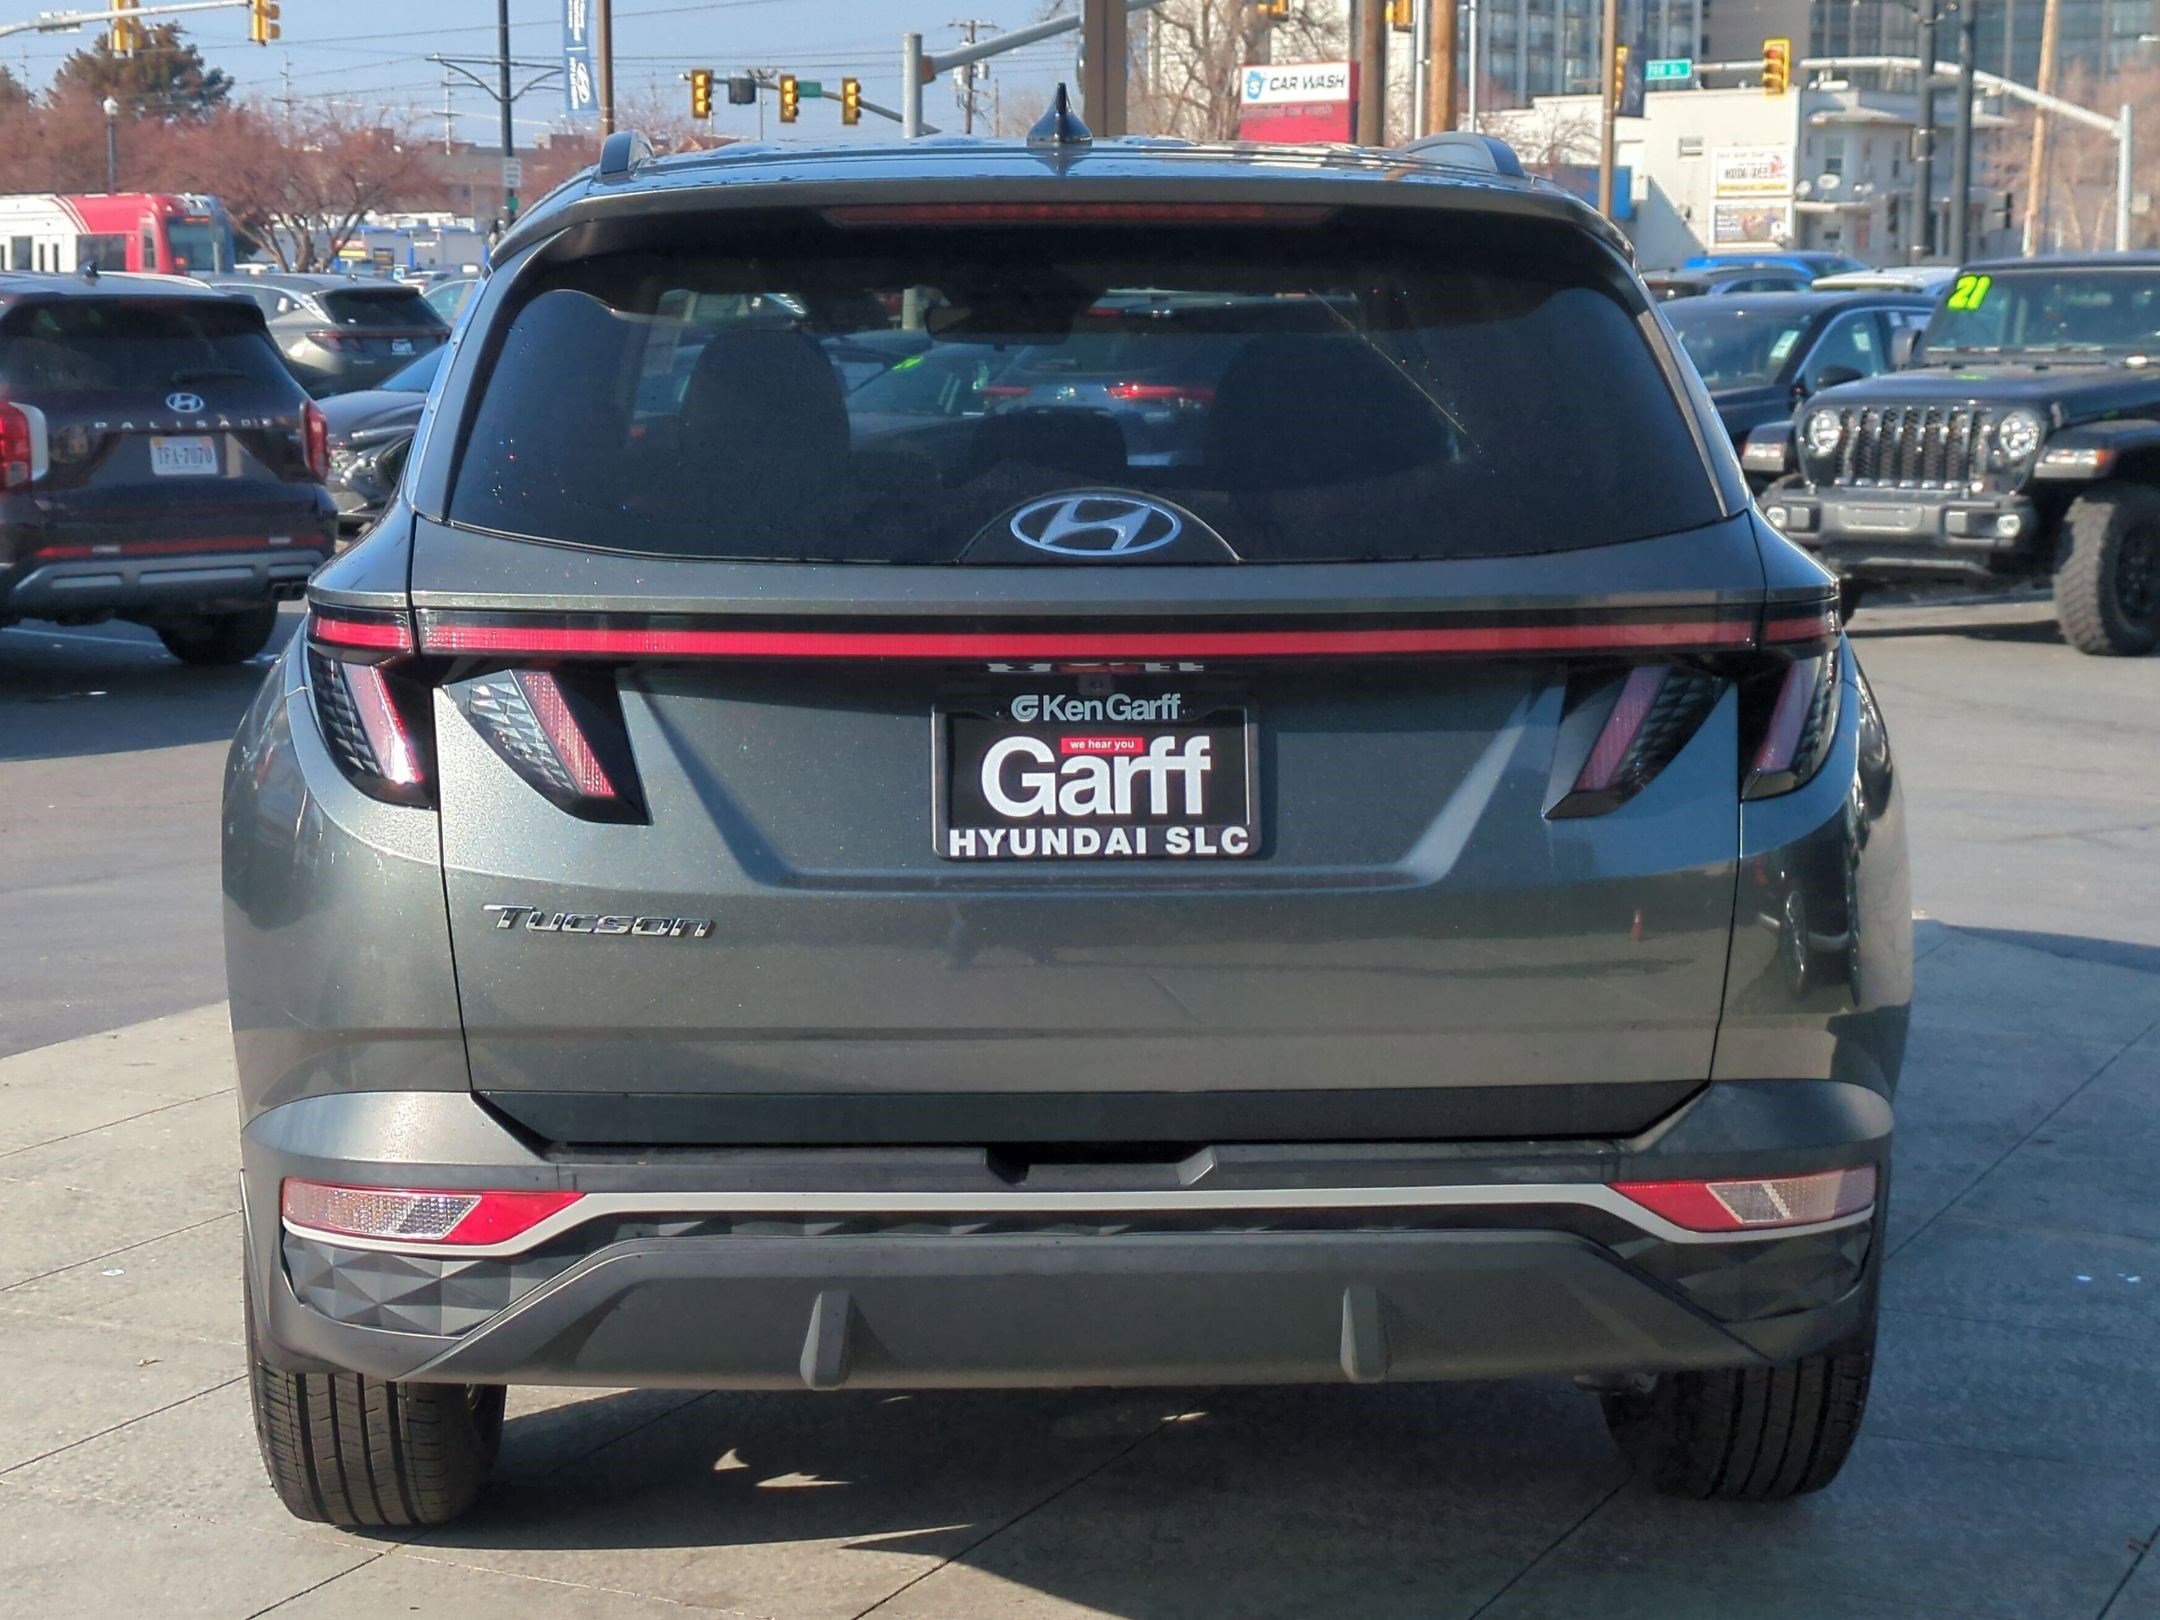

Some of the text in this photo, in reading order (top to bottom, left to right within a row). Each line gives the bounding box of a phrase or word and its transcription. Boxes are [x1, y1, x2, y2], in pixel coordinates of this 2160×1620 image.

[1269, 74, 1346, 91] CAR WASH
[1946, 274, 1992, 311] 21
[94, 418, 273, 430] PALISADE
[1042, 693, 1181, 721] Ken Garff
[1069, 738, 1135, 752] we hear you
[980, 734, 1212, 818] Garff
[949, 826, 1249, 857] HYUNDAI SLC
